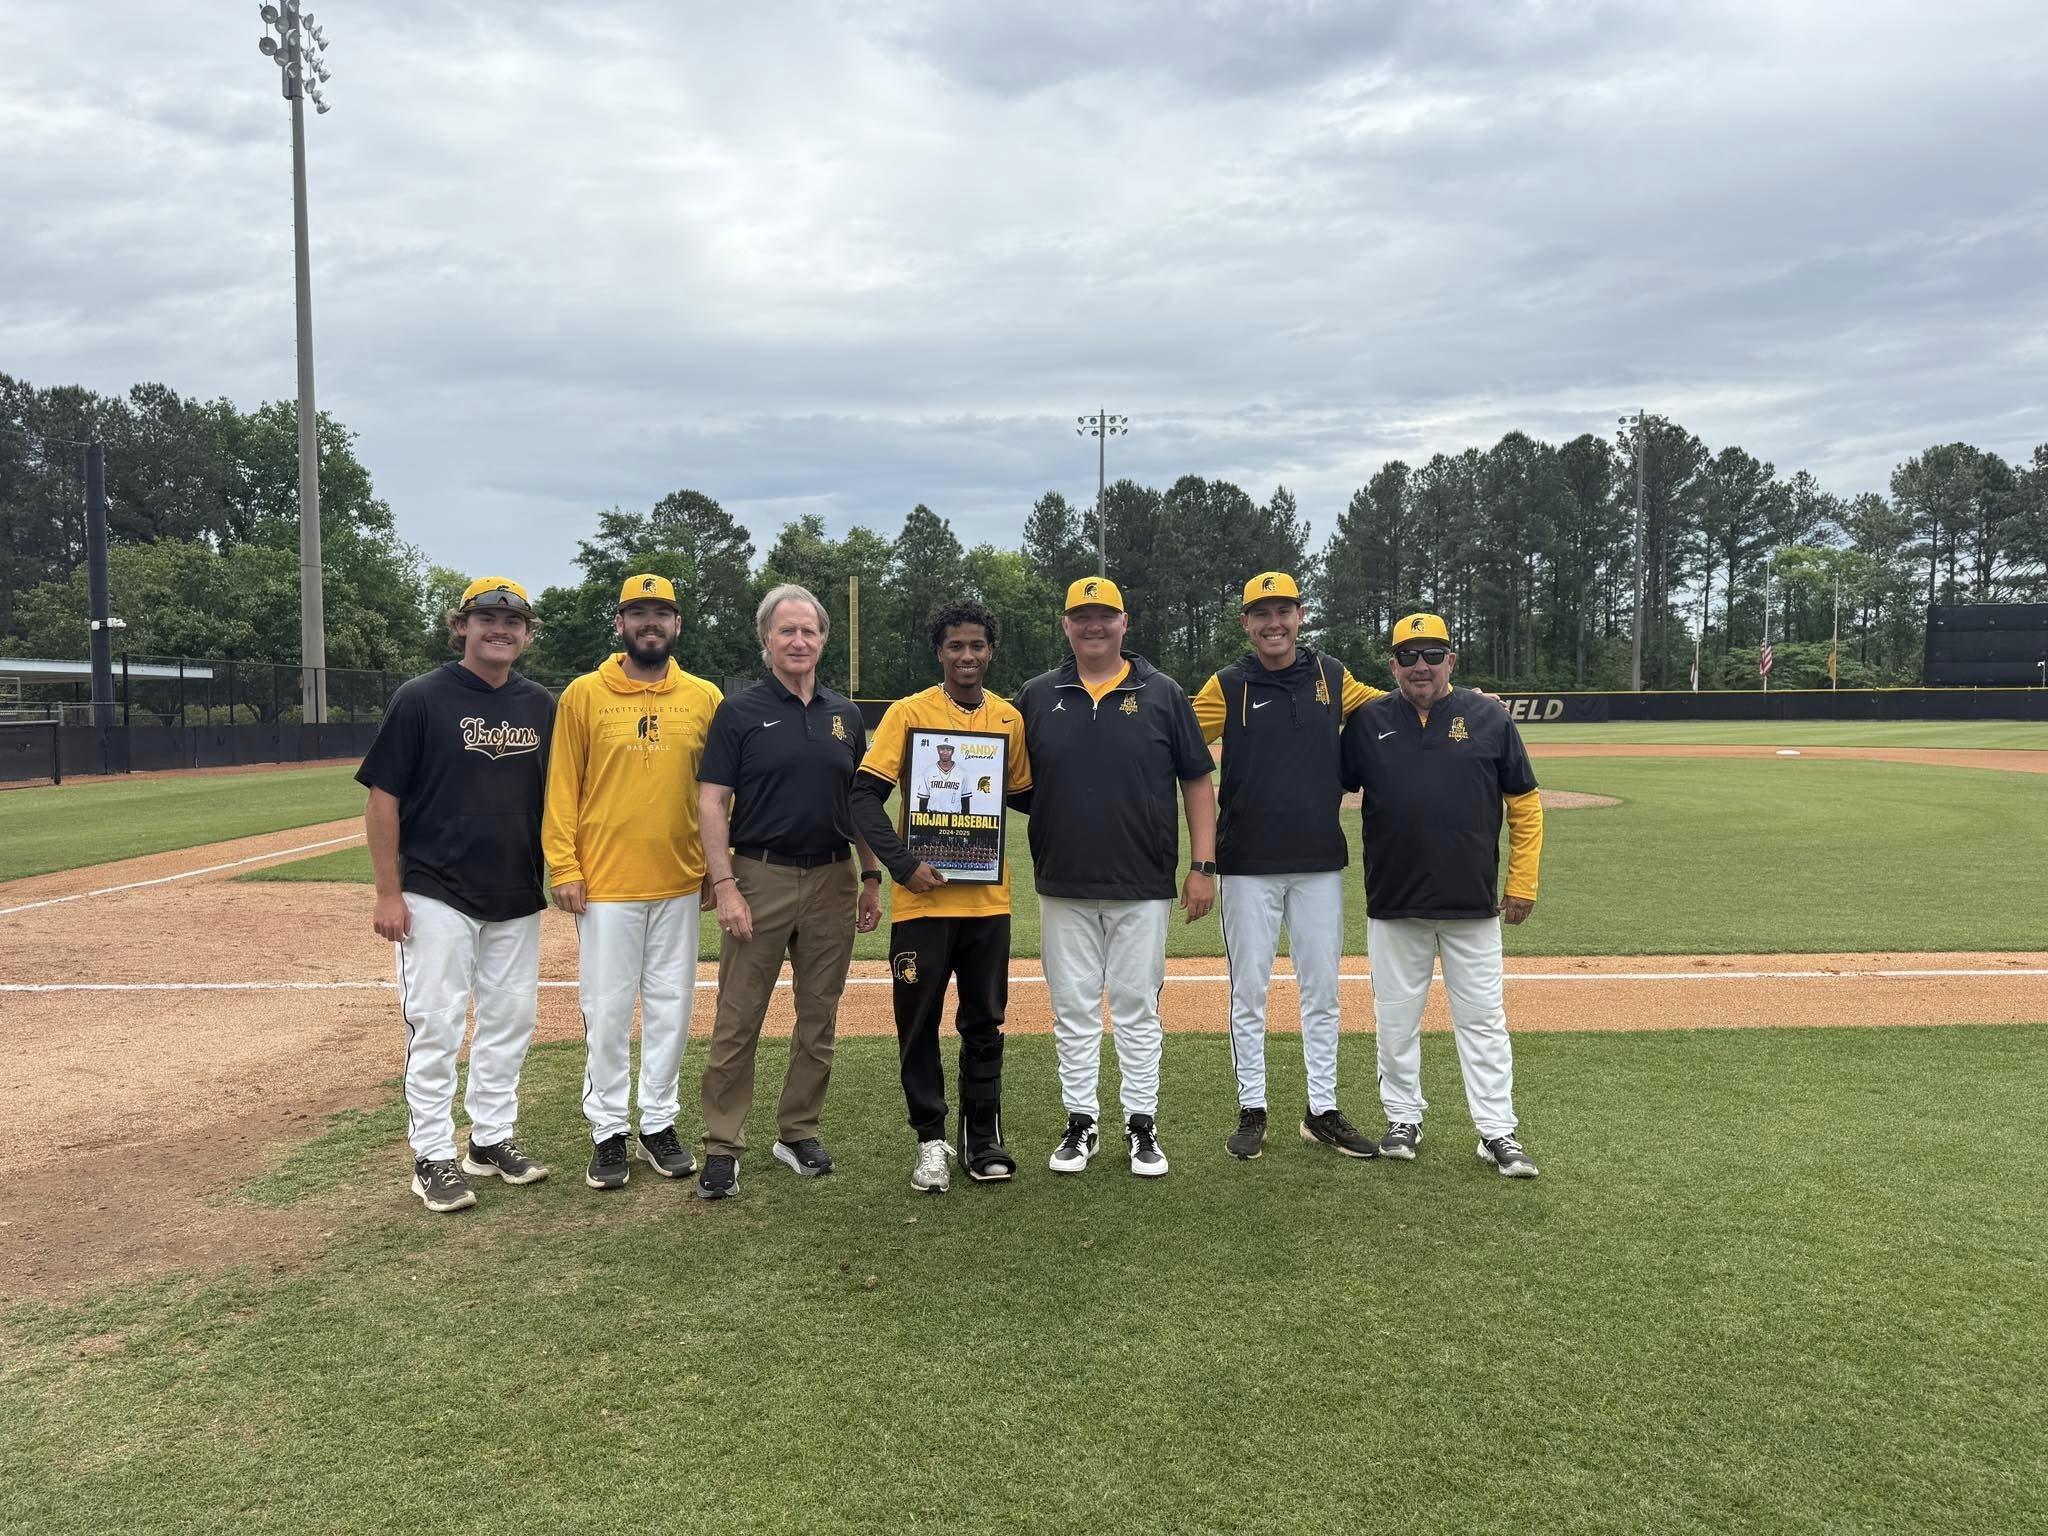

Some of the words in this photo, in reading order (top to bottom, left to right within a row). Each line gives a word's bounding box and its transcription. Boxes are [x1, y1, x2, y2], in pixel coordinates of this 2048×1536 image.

[460, 717, 538, 755] Trojans
[626, 744, 671, 752] BASBALL
[921, 738, 929, 747] #1
[960, 744, 998, 756] RANDY
[911, 812, 948, 826] TROJAN
[951, 814, 999, 829] BASEBALL
